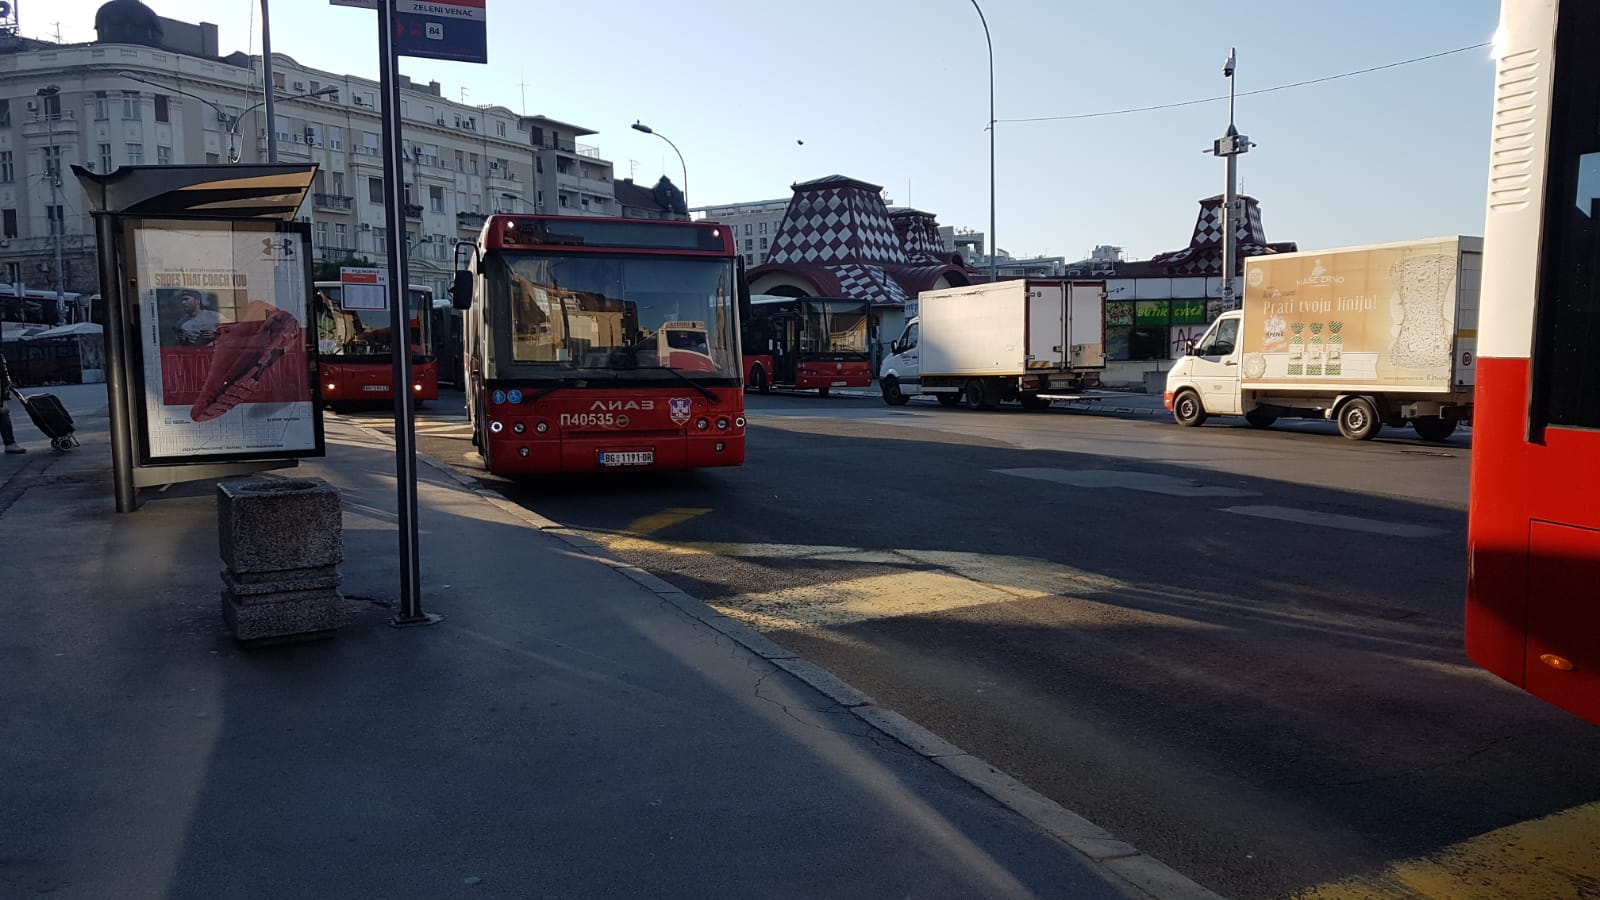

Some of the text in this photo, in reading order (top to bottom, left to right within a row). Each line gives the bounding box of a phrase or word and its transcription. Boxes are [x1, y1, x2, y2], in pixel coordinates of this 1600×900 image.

[413, 4, 473, 17] ZELENI VENAC
[429, 26, 440, 35] B4
[155, 273, 247, 287] SHOES THAT COACH YOU
[1137, 307, 1168, 317] BUTIK
[1263, 299, 1294, 315] Prati
[1299, 298, 1331, 313] tvoju
[590, 400, 655, 411] ЛИАЗ
[560, 413, 613, 426] П40535
[605, 454, 615, 463] BG
